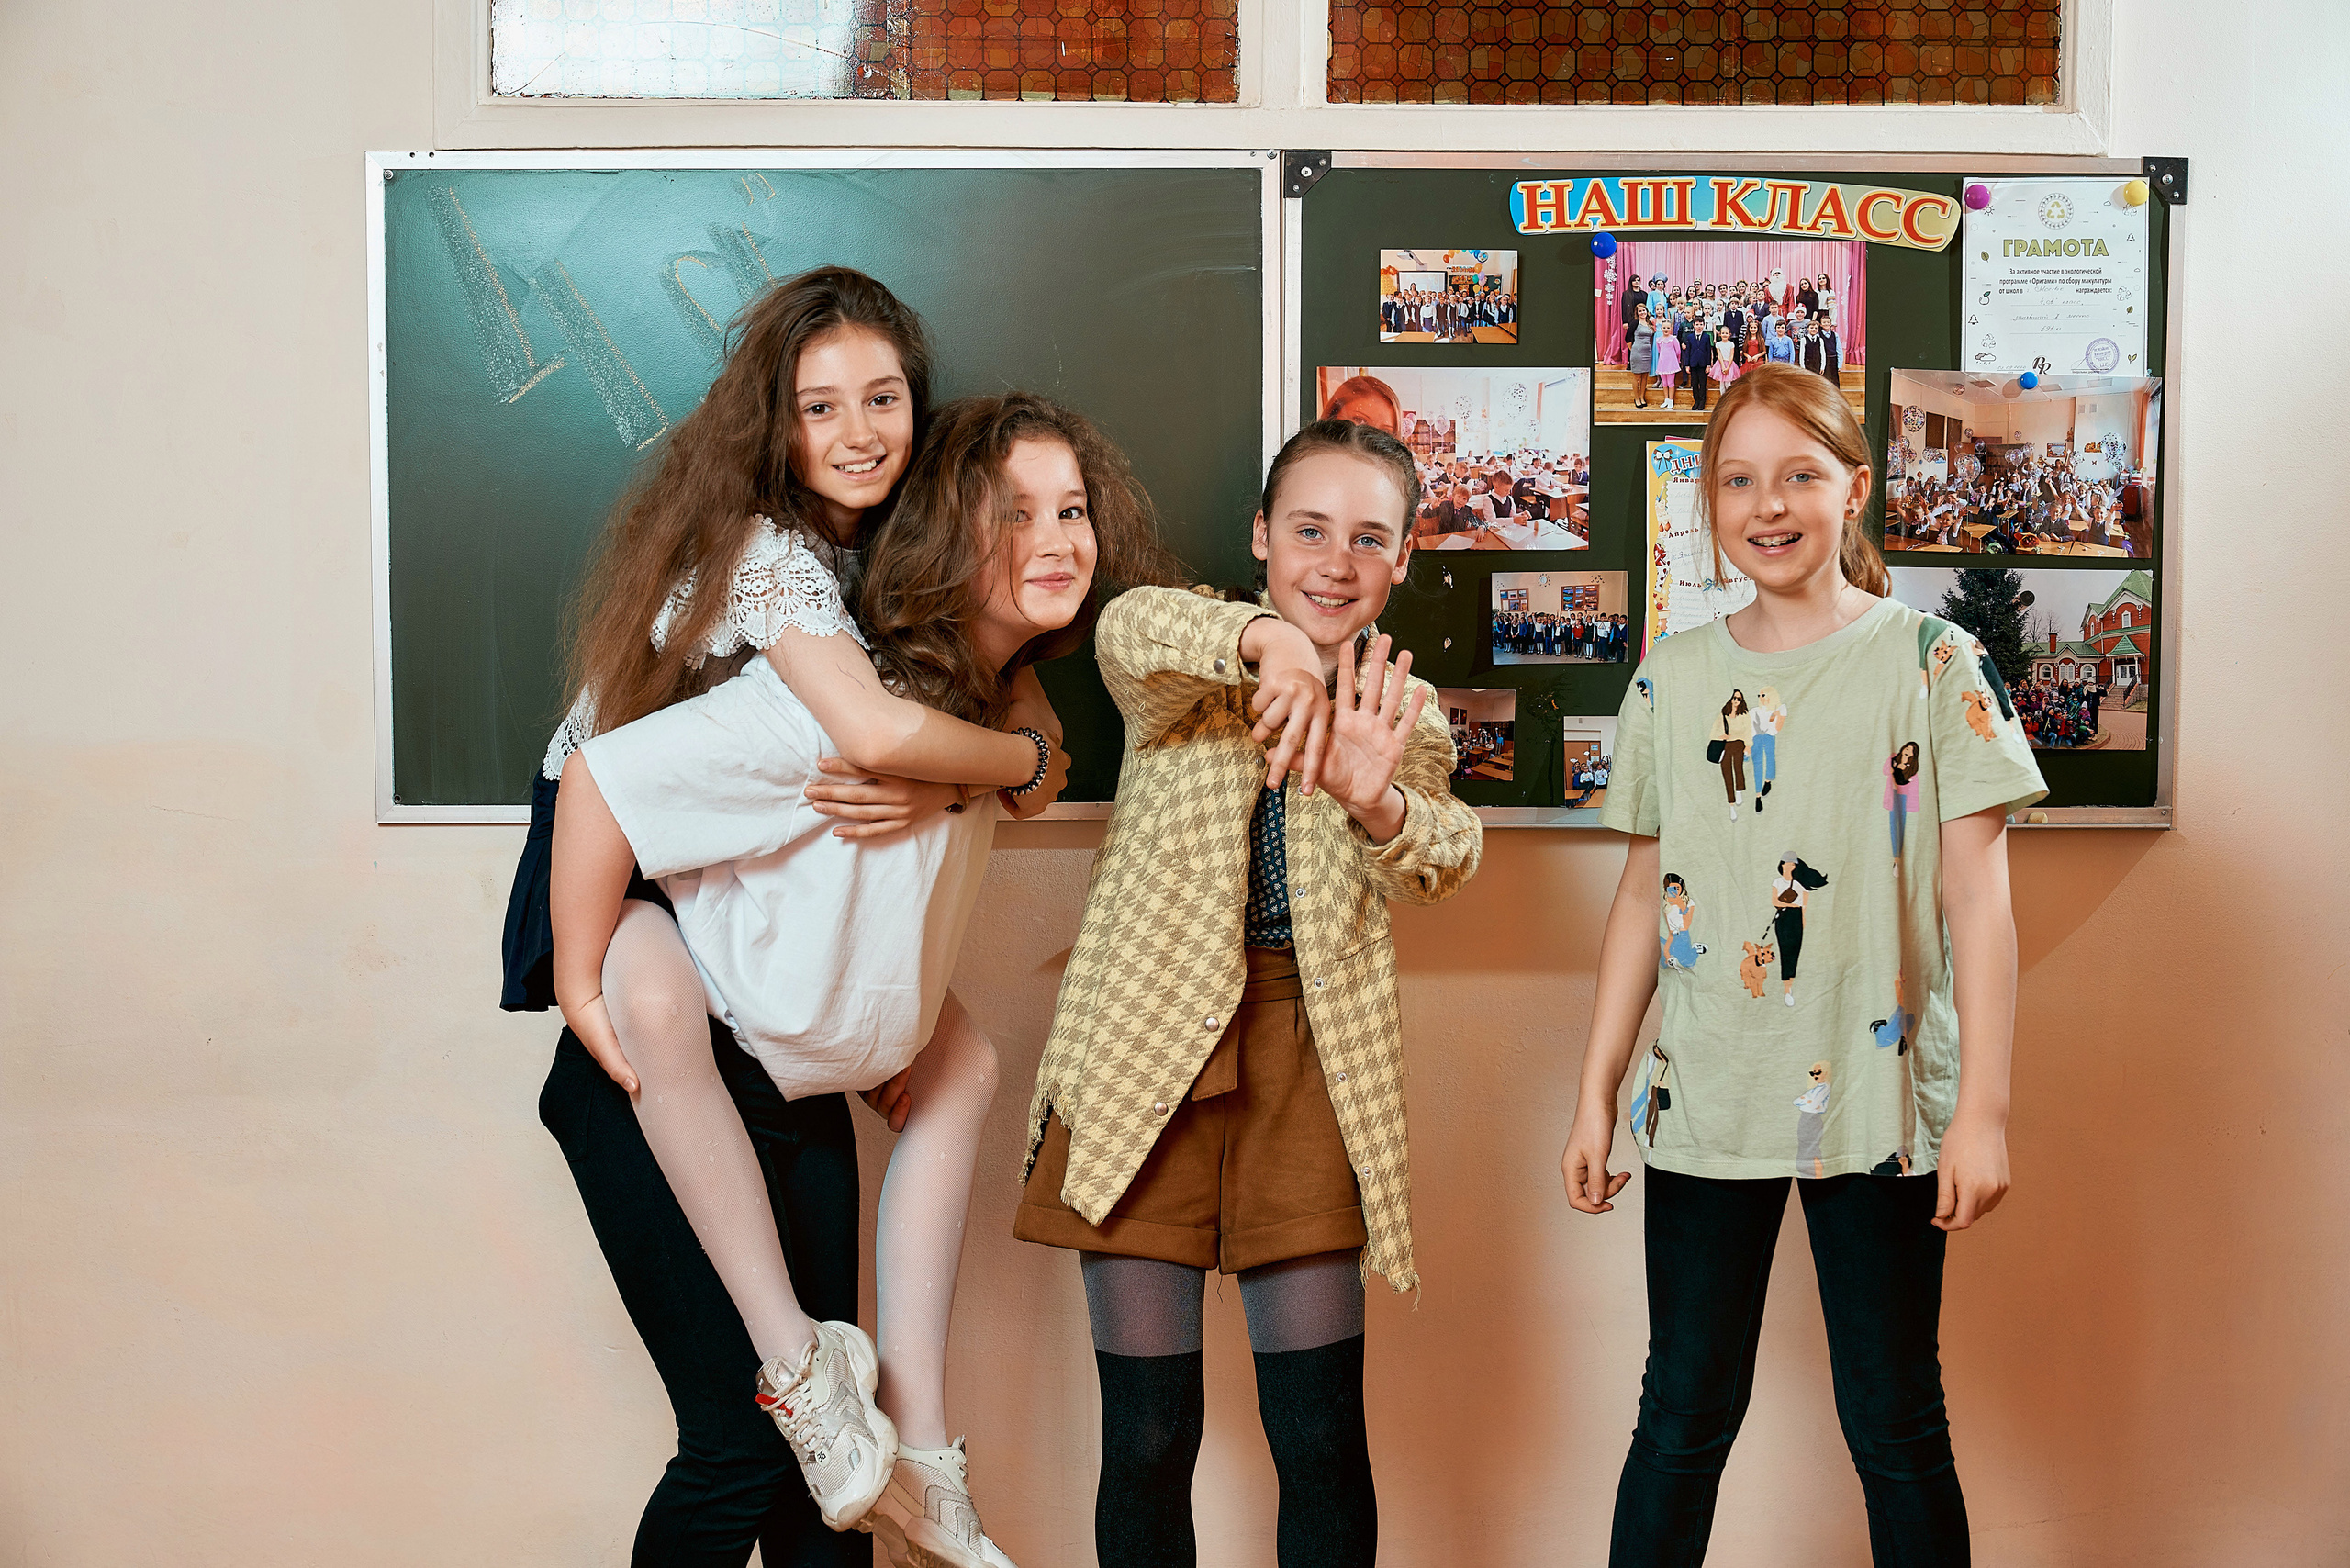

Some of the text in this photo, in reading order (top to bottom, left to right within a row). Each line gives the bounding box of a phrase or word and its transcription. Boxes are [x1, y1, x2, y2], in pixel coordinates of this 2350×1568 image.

[1517, 178, 1953, 248] НАШ КЛАСС
[2003, 238, 2109, 258] ГРАМОТА
[2065, 267, 2102, 275] экологической
[2029, 277, 2058, 286] «Оригами»
[2066, 276, 2080, 286] сбору
[1668, 528, 1699, 539] Апрель
[1679, 579, 1702, 588] Июль
